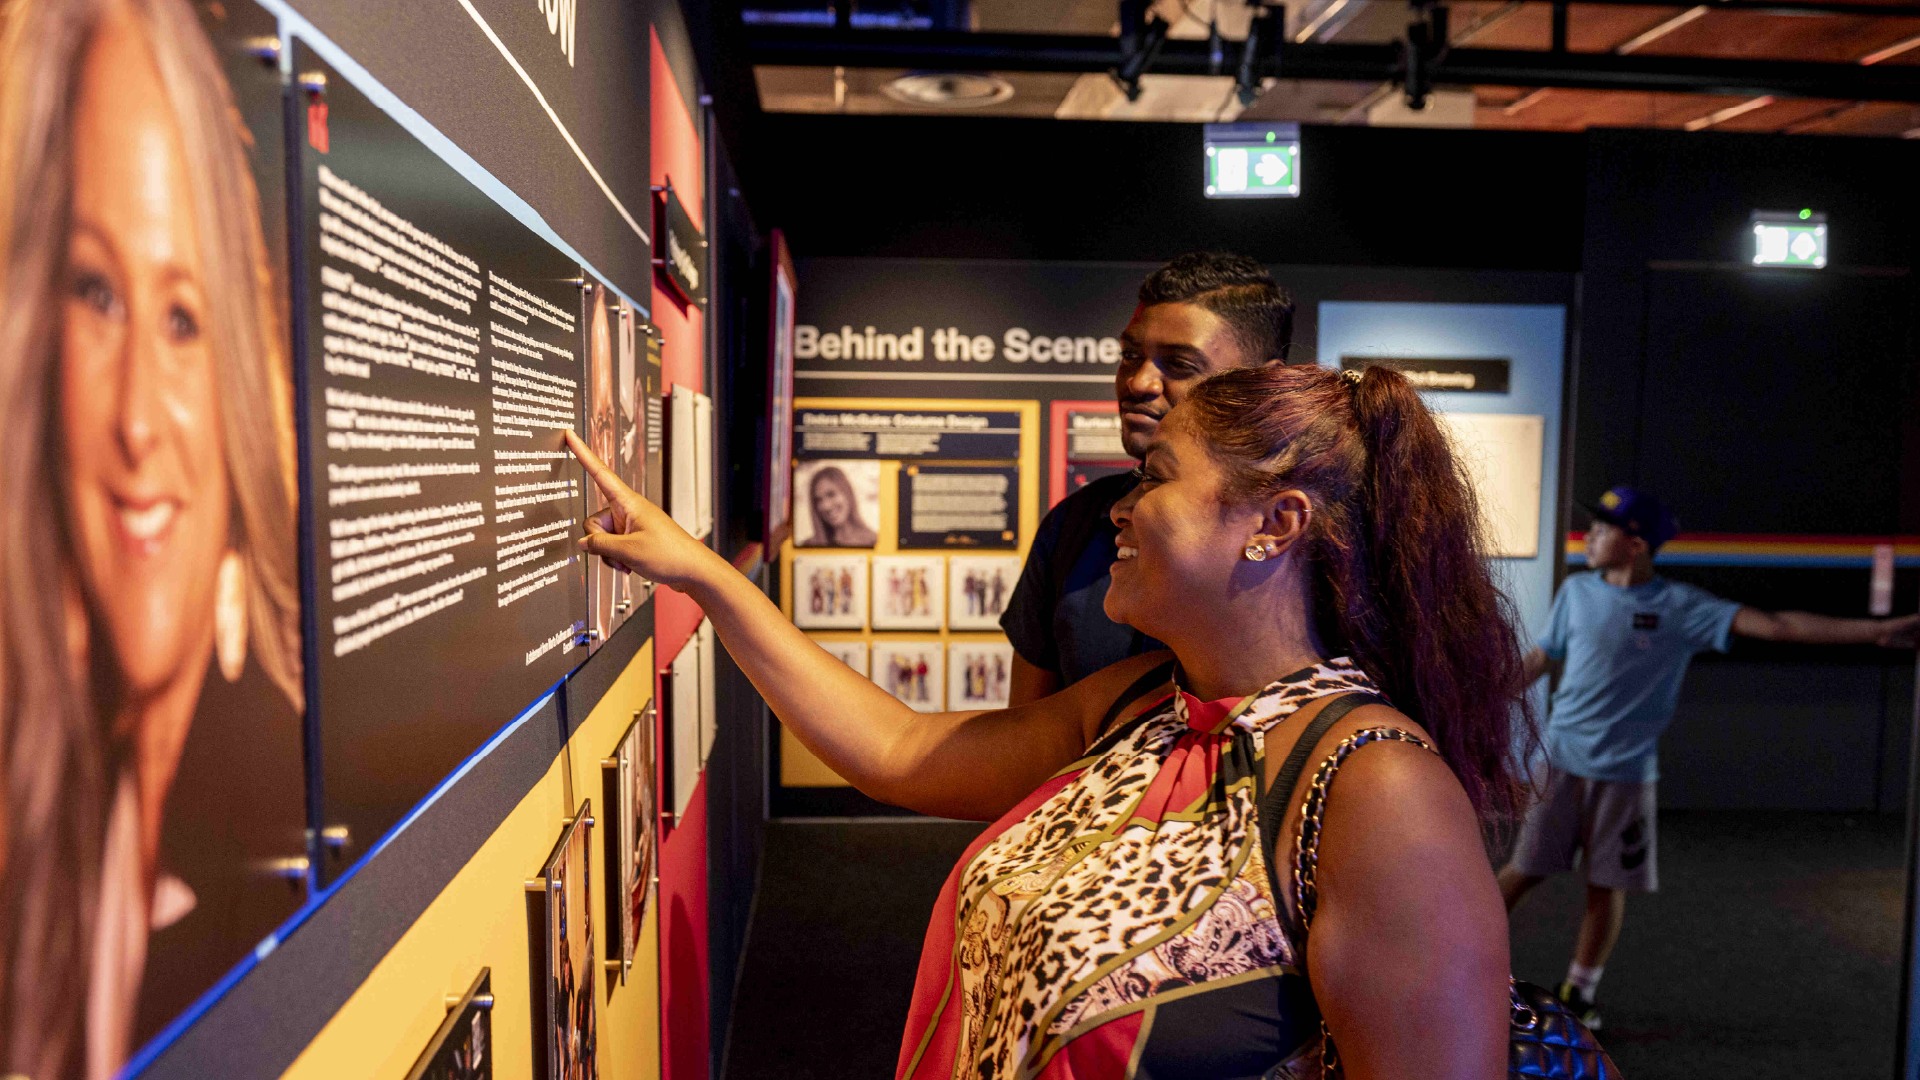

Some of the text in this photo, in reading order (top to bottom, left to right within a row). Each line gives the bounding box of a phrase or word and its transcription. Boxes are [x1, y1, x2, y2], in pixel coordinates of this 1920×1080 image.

[795, 325, 1122, 364] Behind the Scene
